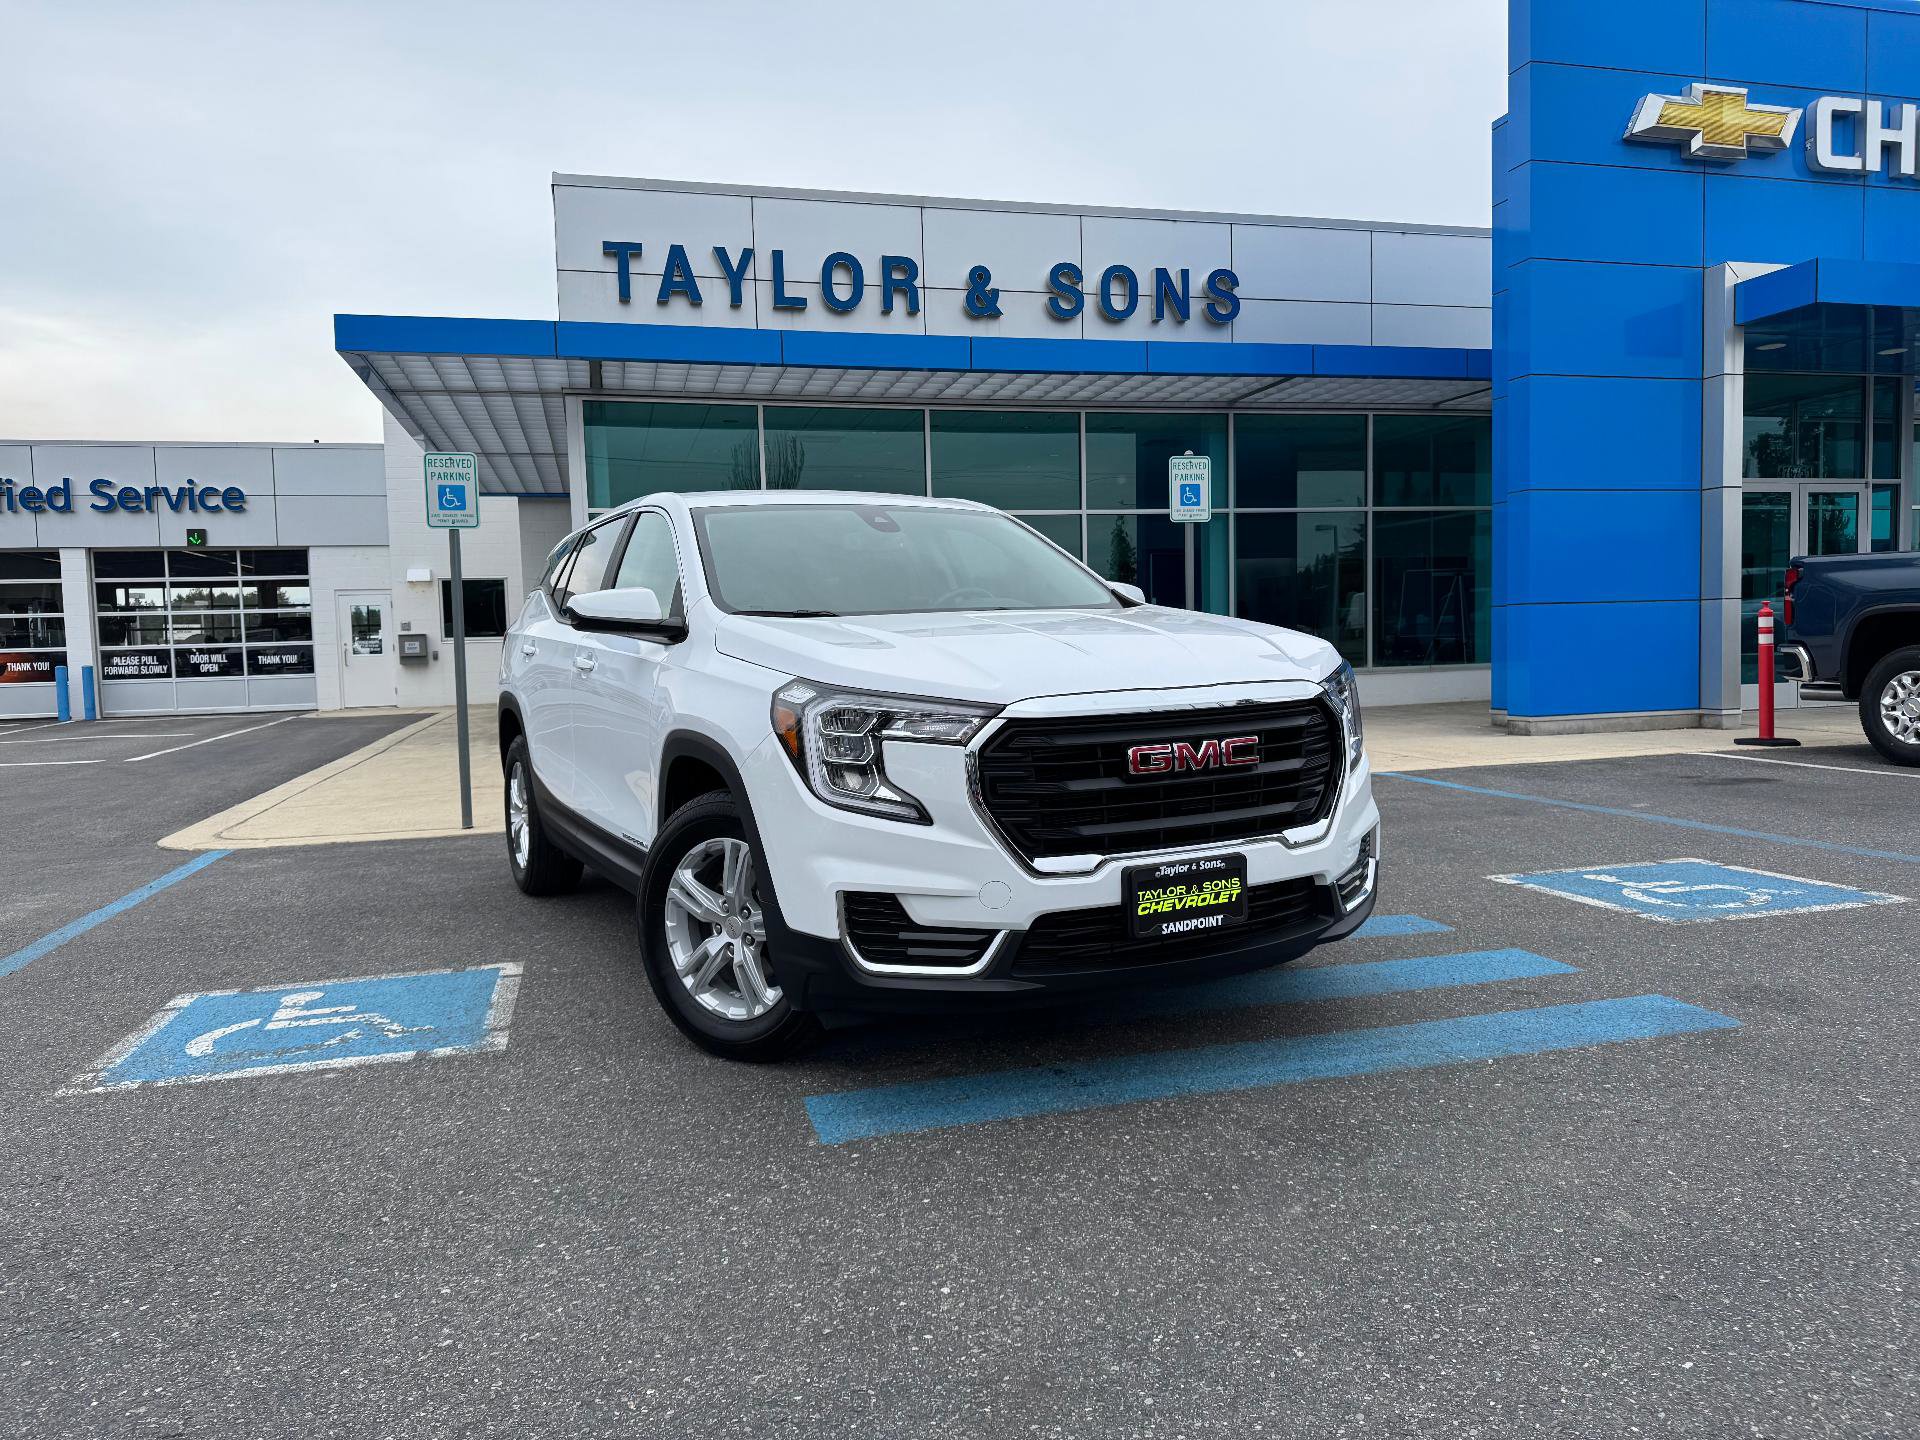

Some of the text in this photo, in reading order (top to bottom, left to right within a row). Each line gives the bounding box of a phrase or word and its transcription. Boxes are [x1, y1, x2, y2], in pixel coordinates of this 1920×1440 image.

[602, 240, 1242, 324] TAYLOR & SONS
[427, 458, 472, 469] RESERVED
[1172, 461, 1207, 471] RESERVED
[430, 471, 471, 482] PARKING
[1174, 473, 1205, 482] PARKING
[89, 478, 246, 513] Service
[113, 655, 159, 666] PLEASE PULL
[190, 653, 228, 664] DOOR WILL
[257, 654, 298, 665] THANK YOU!
[6, 661, 50, 672] THANK YOU!
[104, 665, 168, 675] FORWARD SLOWLY
[200, 663, 219, 673] OPEN
[1128, 735, 1260, 774] GMC
[1160, 864, 1190, 877] Taylor
[1199, 859, 1222, 870] Sons
[1138, 877, 1240, 902] TAYLOR & SONS
[1137, 889, 1242, 916] CHEVROLET
[1161, 915, 1224, 935] SANDPOINT
